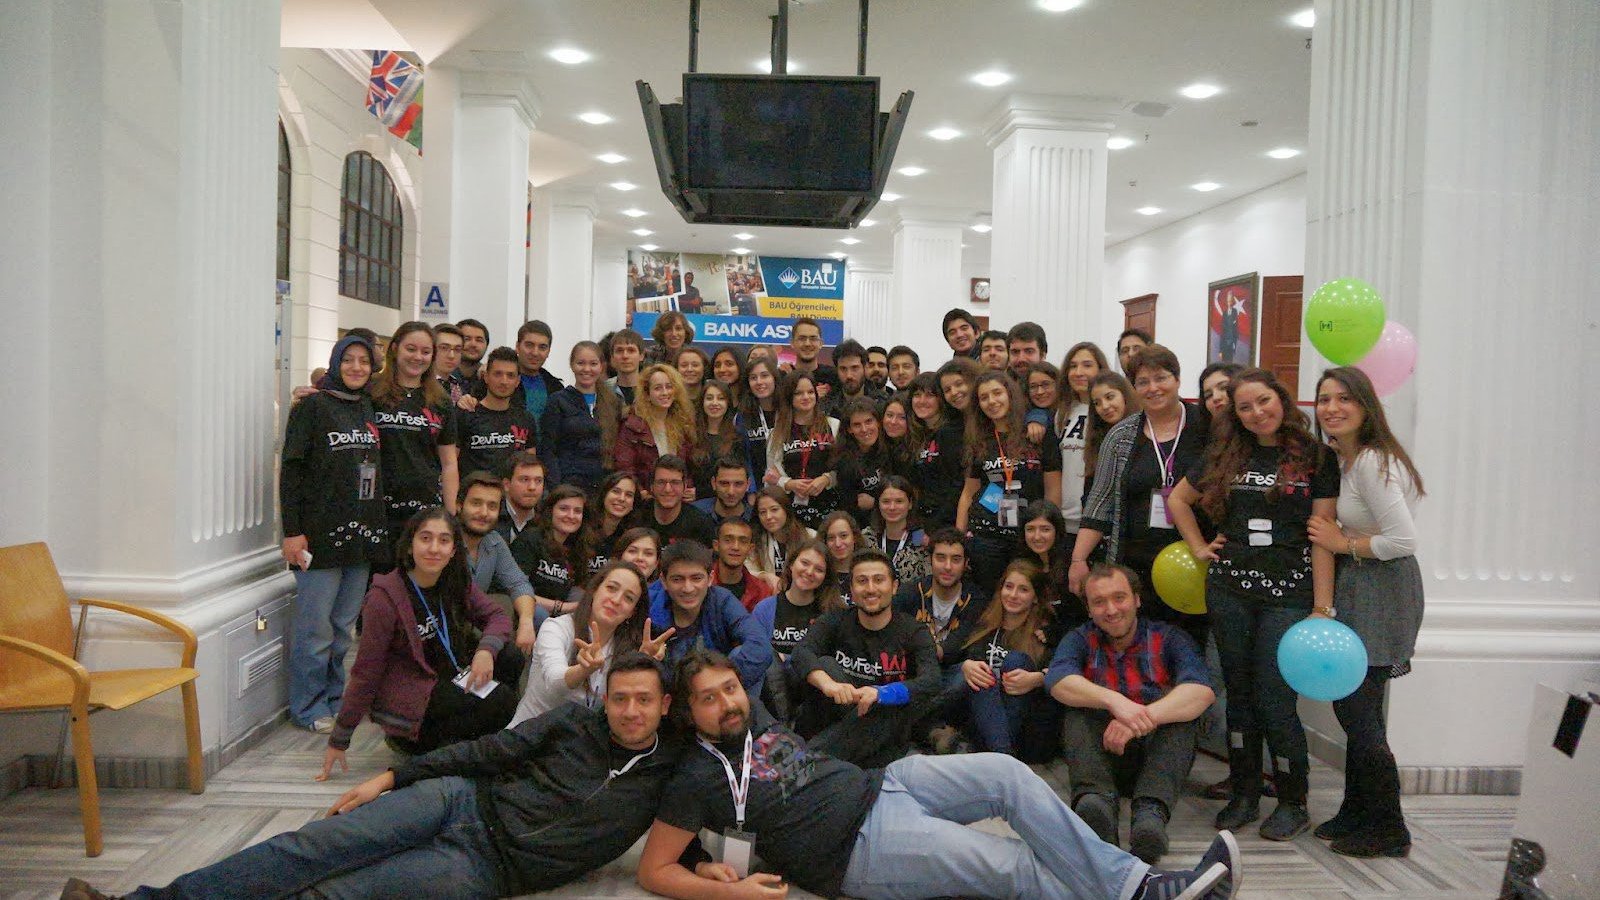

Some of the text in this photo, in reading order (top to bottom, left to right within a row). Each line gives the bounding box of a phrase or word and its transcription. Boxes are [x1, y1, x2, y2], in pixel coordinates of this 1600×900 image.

[801, 269, 838, 286] BAU
[425, 286, 444, 307] A
[769, 301, 788, 310] BAU
[704, 322, 758, 338] BANK
